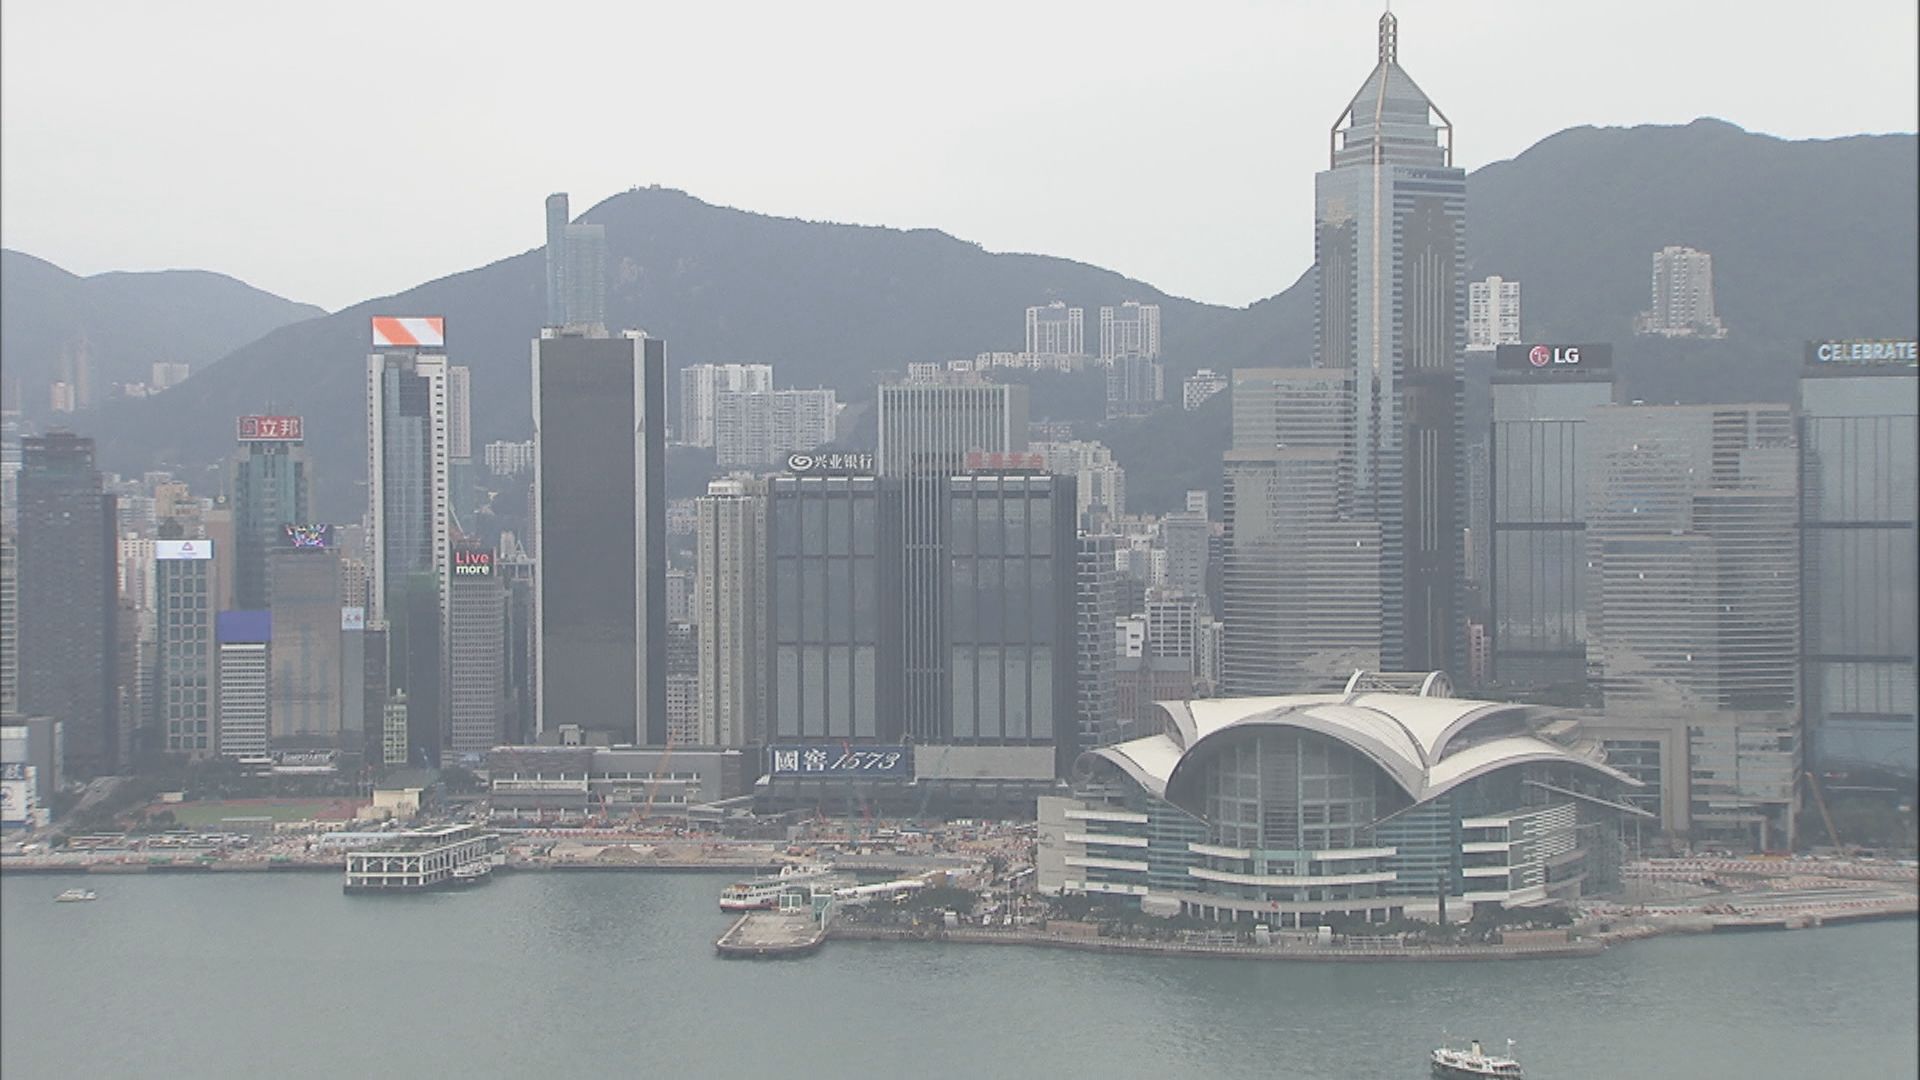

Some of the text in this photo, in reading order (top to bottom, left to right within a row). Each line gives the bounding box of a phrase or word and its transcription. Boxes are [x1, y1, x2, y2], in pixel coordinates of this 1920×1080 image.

[1554, 347, 1579, 363] LG
[1817, 342, 1918, 361] CELEBRATE
[260, 419, 298, 437] 立邦
[814, 454, 873, 469] 兴业银行
[455, 550, 489, 563] Live
[456, 564, 490, 574] more
